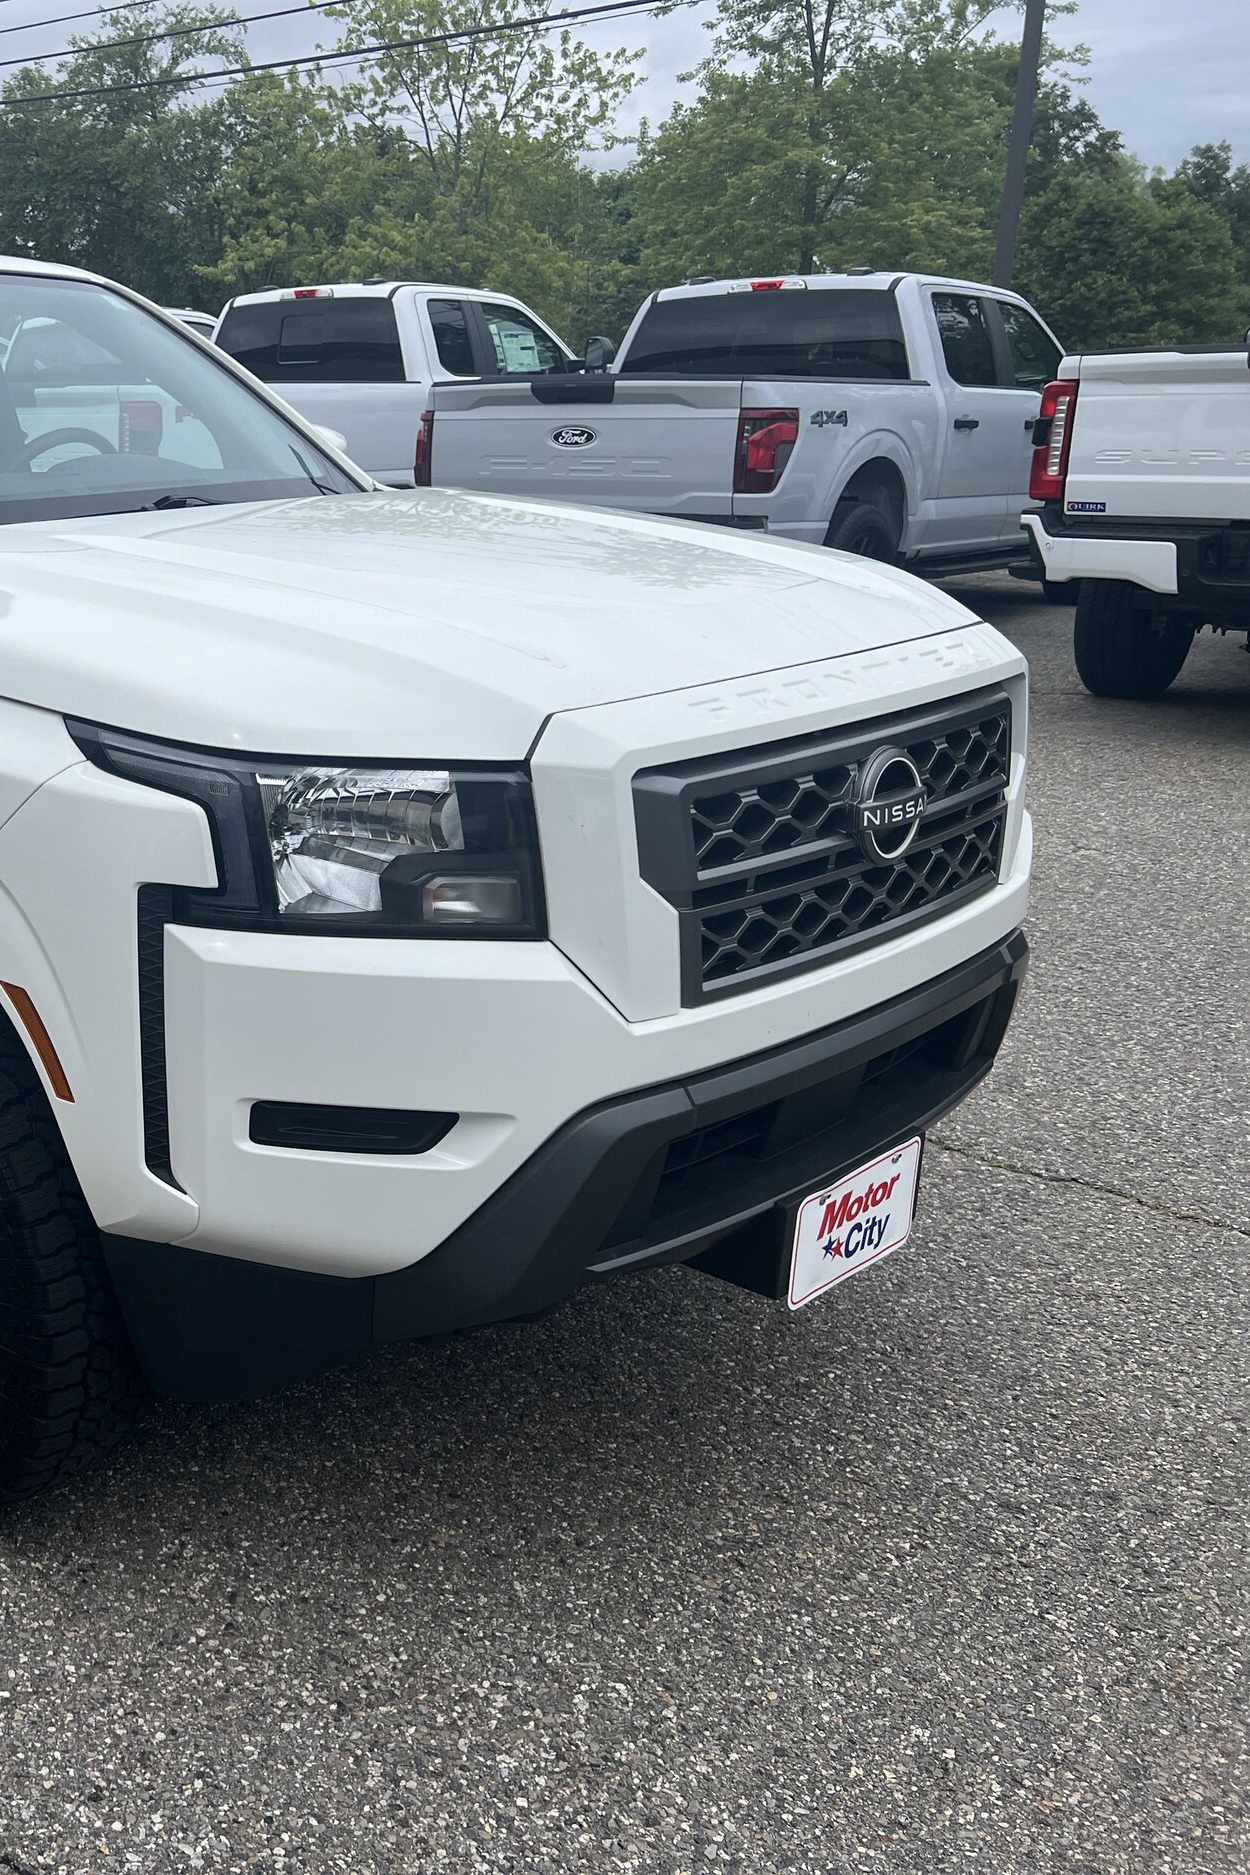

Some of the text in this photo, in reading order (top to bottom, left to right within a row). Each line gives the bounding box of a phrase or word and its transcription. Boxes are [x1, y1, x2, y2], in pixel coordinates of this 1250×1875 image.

[558, 429, 588, 445] Ford
[478, 455, 673, 477] F-150
[1068, 502, 1105, 511] QUIRK
[817, 1172, 901, 1241] Motor
[844, 1213, 891, 1259] City
